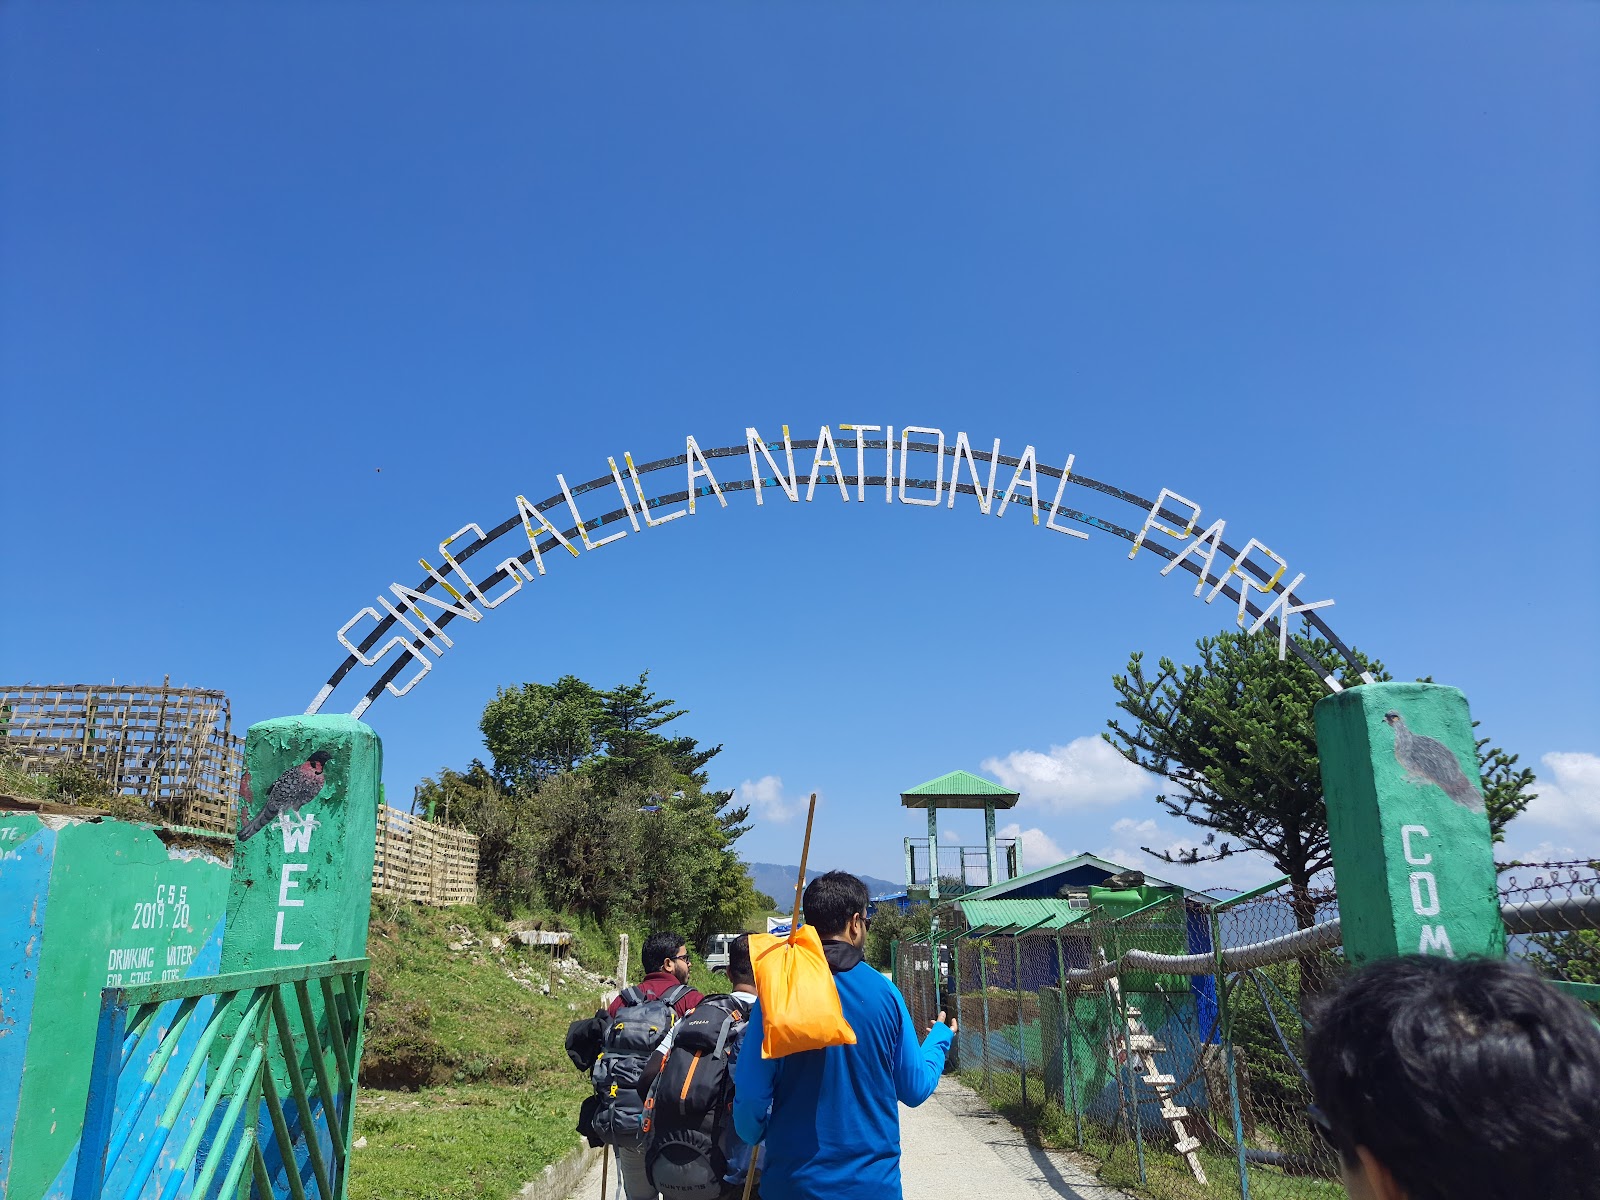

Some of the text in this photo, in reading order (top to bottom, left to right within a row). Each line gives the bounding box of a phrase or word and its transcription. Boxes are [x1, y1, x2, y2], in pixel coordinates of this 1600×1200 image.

[337, 424, 1336, 697] SINGALILA NATIONAL PARK
[273, 812, 316, 951] WEL
[1400, 824, 1455, 958] COM
[106, 973, 123, 988] FOR
[166, 945, 193, 966] WATER
[659, 1181, 693, 1191] HUNTER
